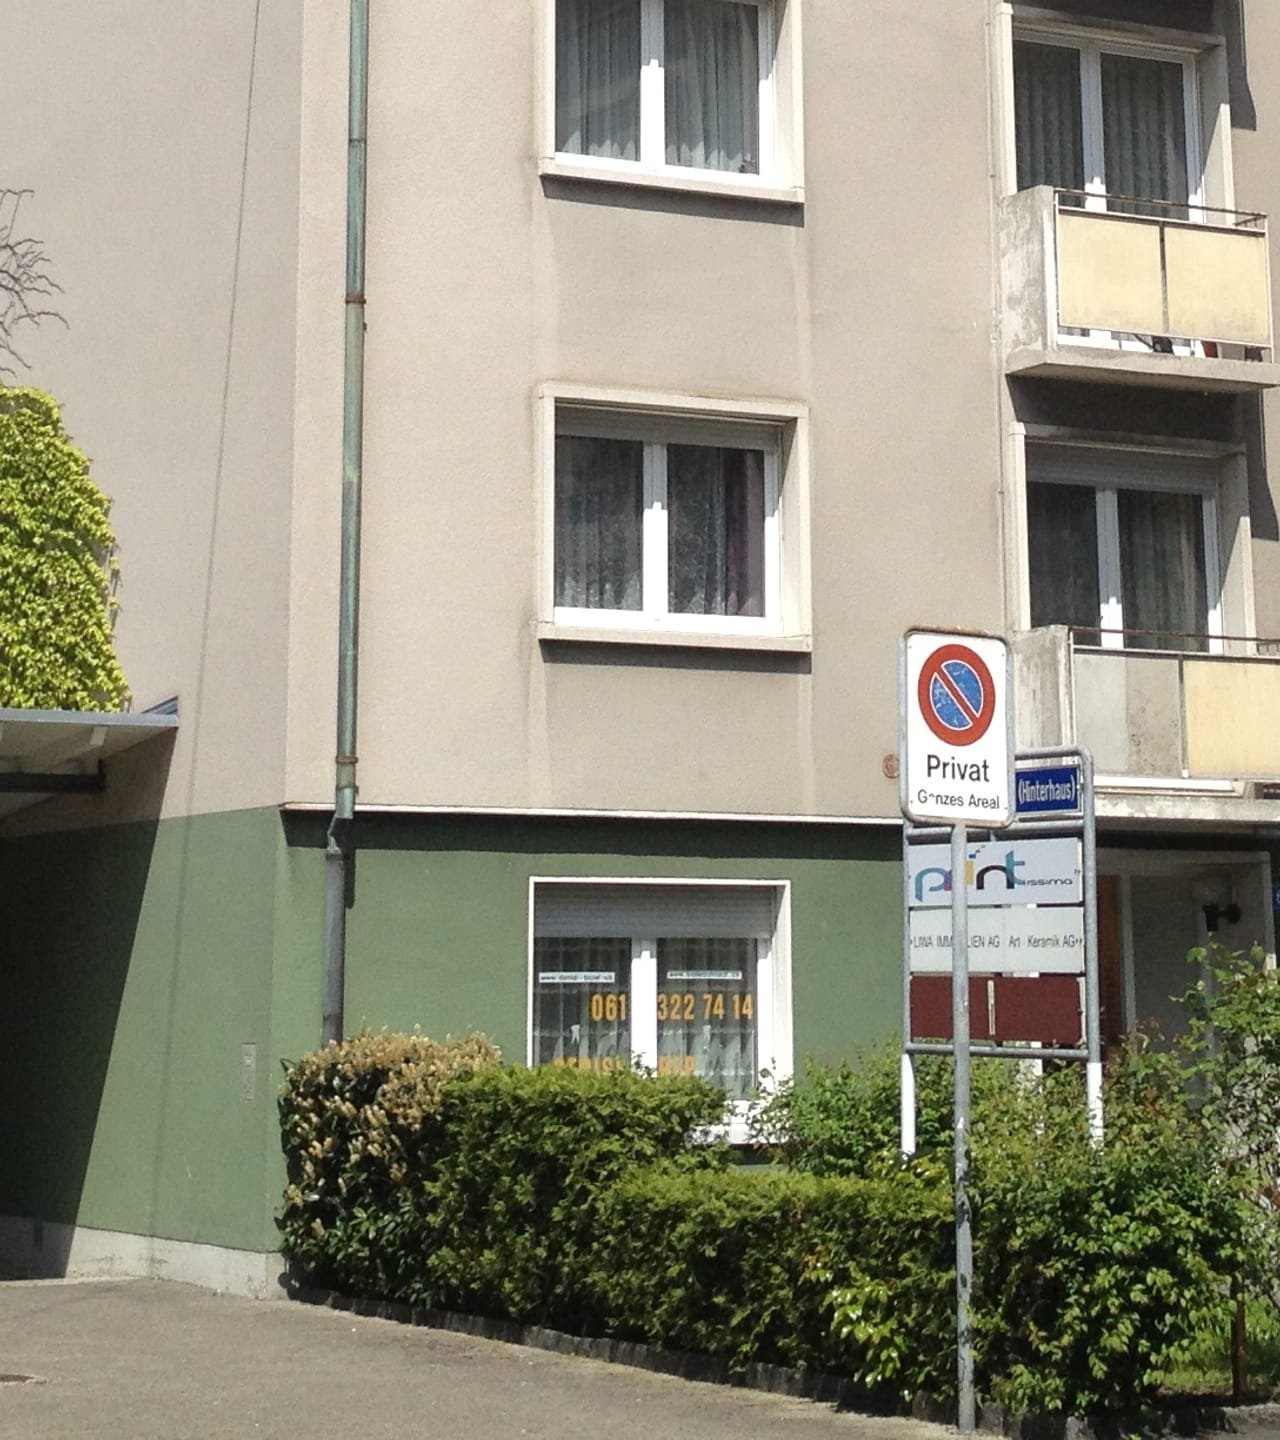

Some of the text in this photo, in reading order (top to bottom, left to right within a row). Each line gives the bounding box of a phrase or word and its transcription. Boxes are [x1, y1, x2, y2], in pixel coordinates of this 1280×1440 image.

[926, 753, 990, 783] Privat
[968, 793, 1000, 810] Areal
[987, 934, 1000, 949] AG
[591, 993, 753, 1021] 061 322 74 14
